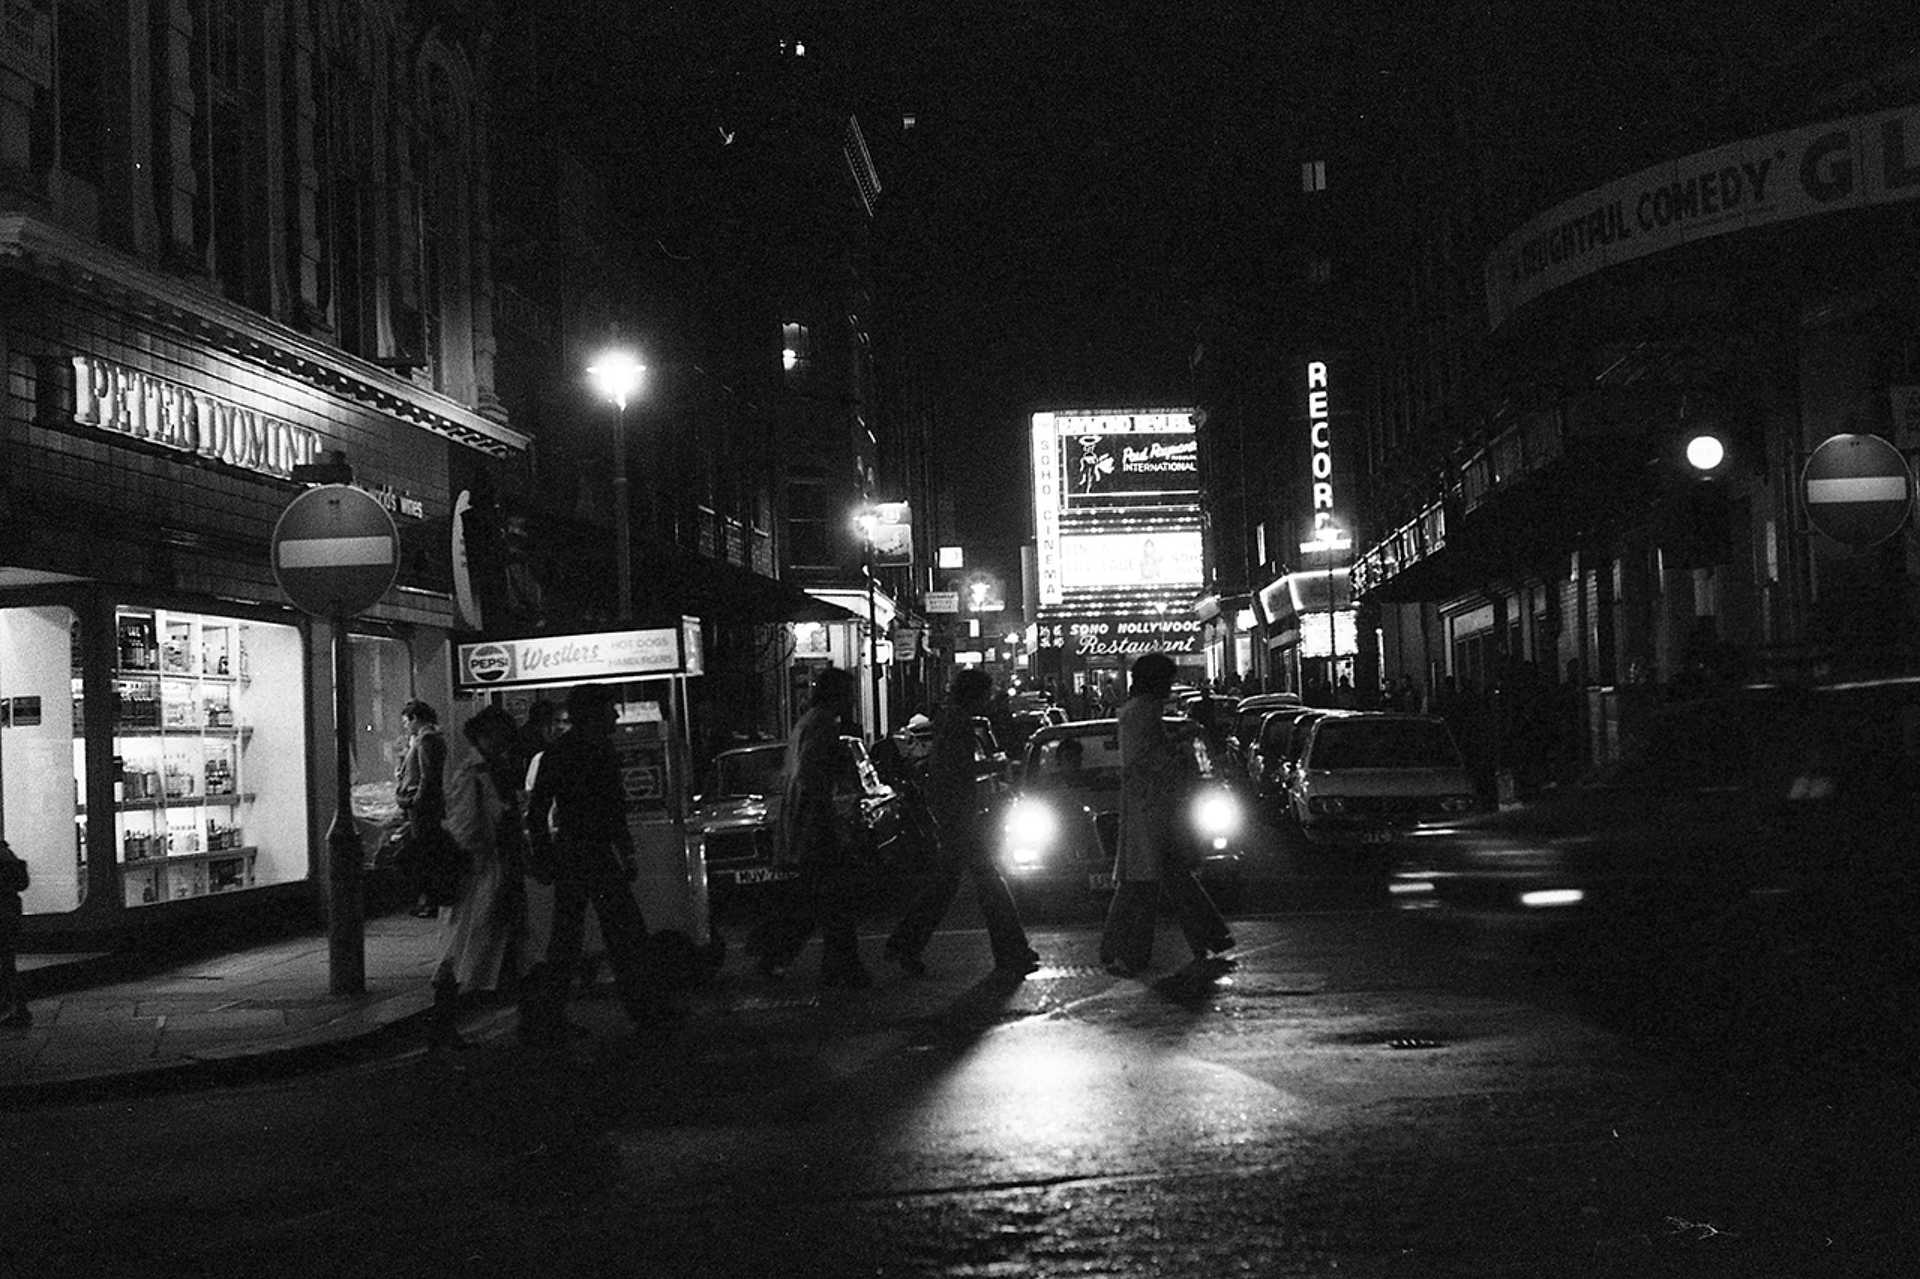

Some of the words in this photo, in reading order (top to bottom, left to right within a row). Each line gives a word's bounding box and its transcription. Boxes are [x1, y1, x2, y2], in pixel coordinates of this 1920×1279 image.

[73, 356, 196, 452] PETER
[1122, 461, 1198, 473] INTERNATIONAL
[1070, 622, 1110, 636] SOHO
[1076, 635, 1196, 655] Restaurant
[471, 657, 508, 669] PEPSI
